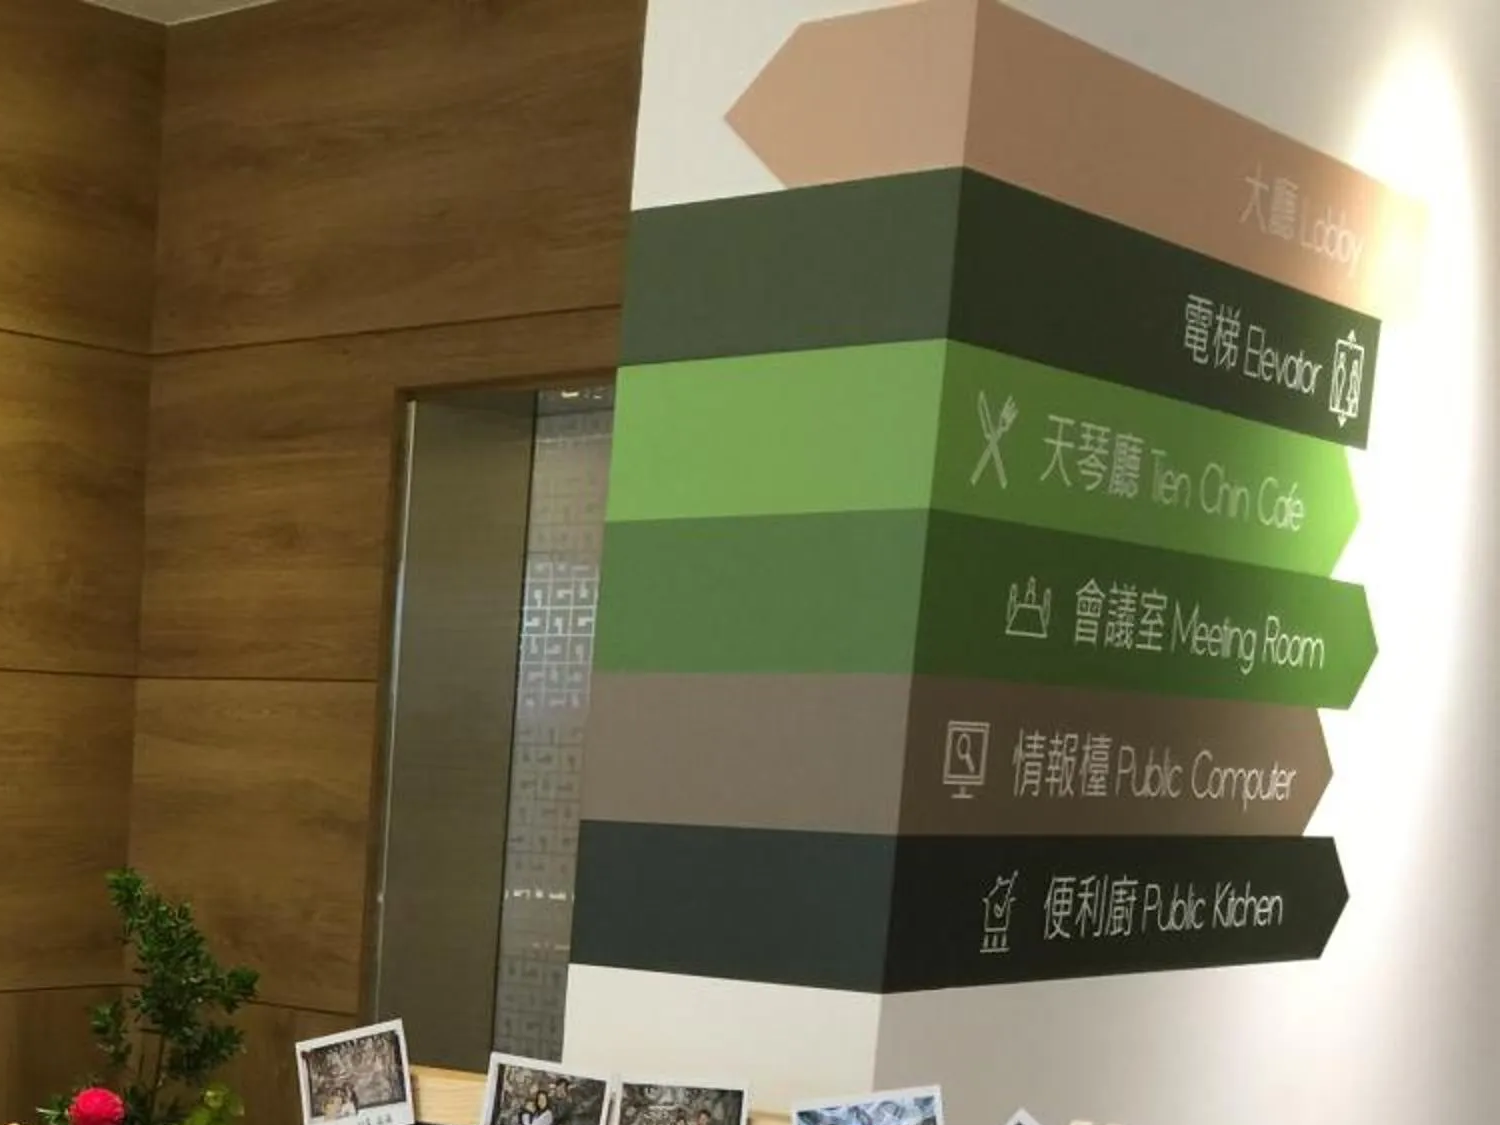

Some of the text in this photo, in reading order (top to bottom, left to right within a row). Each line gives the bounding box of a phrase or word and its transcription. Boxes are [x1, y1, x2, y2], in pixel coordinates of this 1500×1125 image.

[1301, 197, 1364, 277] Lobby
[1183, 294, 1323, 396] 電梯 Elevator
[1040, 414, 1146, 500] 天琴廳
[1074, 578, 1326, 675] 會議室 Meeting Room
[1116, 745, 1182, 799] Public
[1192, 750, 1297, 812] Computer
[1043, 875, 1284, 941] 便利廚 Public Kitchen
